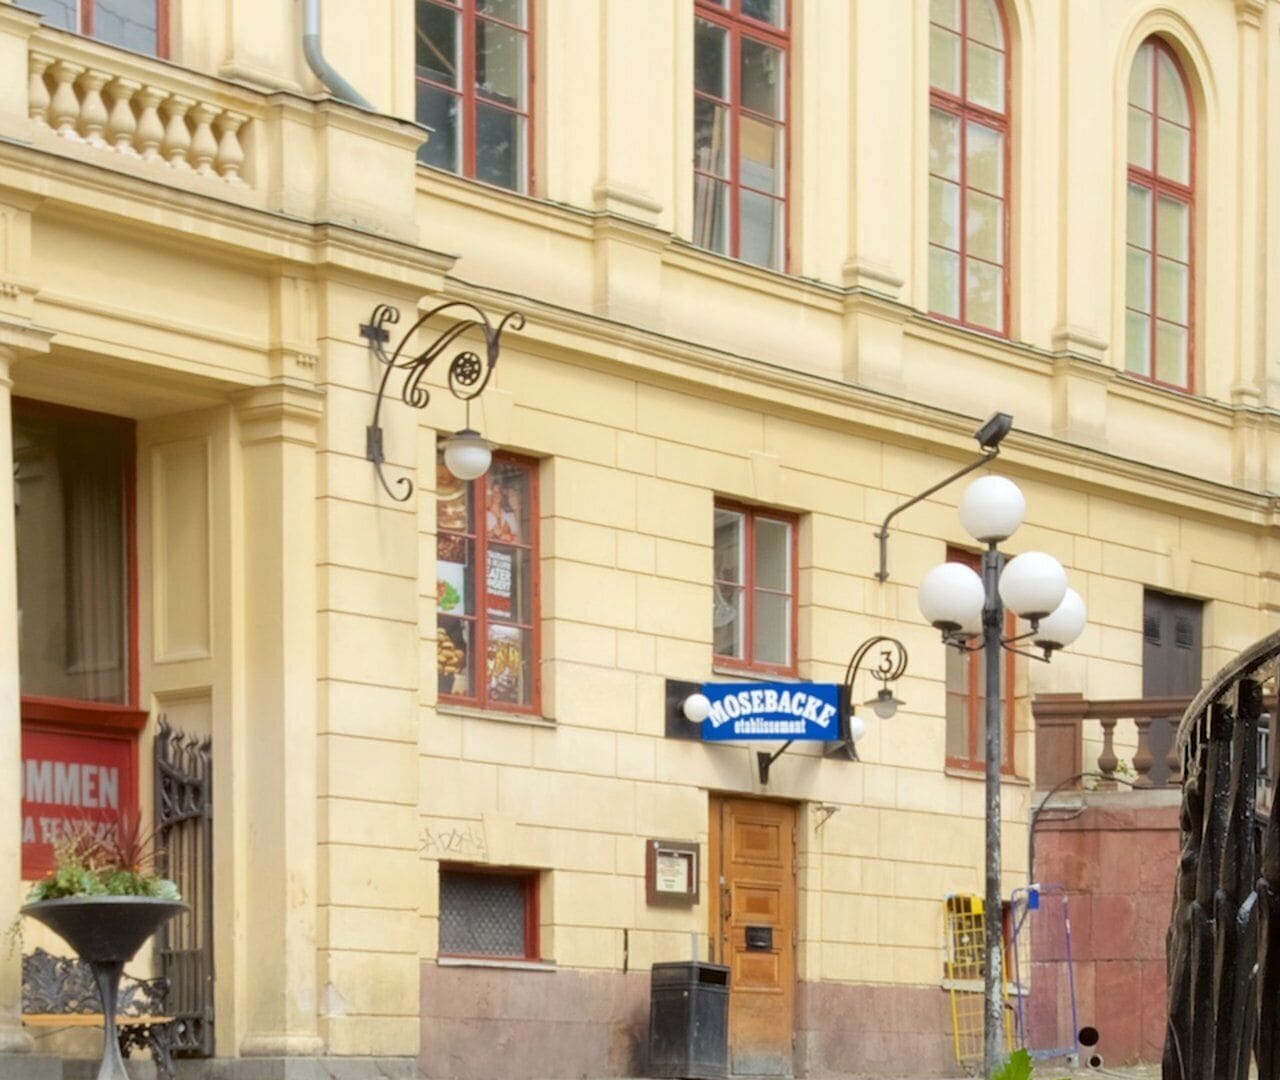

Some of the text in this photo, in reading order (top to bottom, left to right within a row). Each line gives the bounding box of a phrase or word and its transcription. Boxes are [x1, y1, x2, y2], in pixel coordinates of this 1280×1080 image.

[877, 651, 894, 674] 3
[708, 689, 837, 728] MOSEBACKE
[734, 717, 806, 734] etablissement
[21, 759, 119, 809] MMEN
